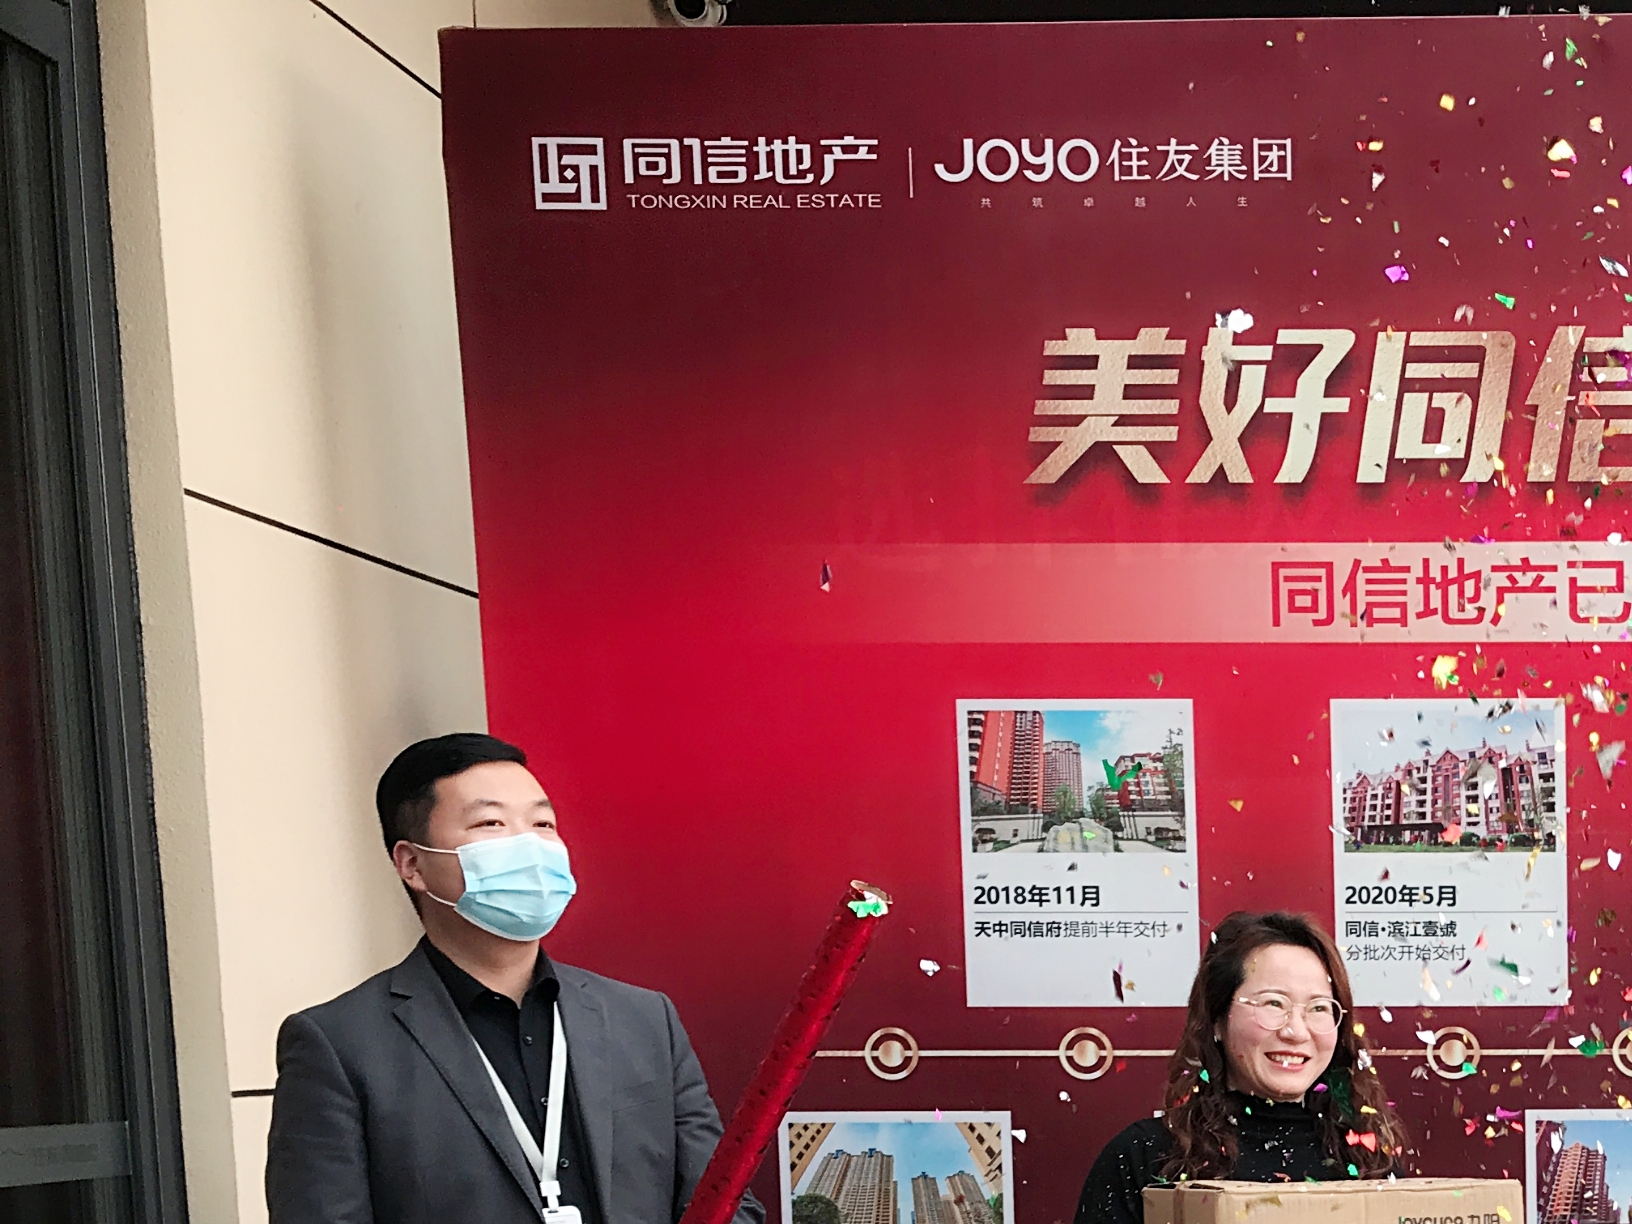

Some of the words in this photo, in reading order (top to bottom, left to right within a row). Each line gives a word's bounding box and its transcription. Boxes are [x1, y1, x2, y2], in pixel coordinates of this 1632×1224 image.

[622, 135, 879, 186] 同信地产
[933, 137, 1101, 183] JOYO
[1105, 136, 1293, 183] 住友集团
[626, 193, 728, 209] TONGXIN
[733, 193, 791, 209] REAL
[796, 192, 883, 208] ESTATE
[973, 884, 1101, 908] 2018年11月
[1344, 884, 1457, 908] 2020年5月
[973, 920, 1169, 939] 天中同信府提前半年交付
[1345, 943, 1467, 962] 分批次开始交付
